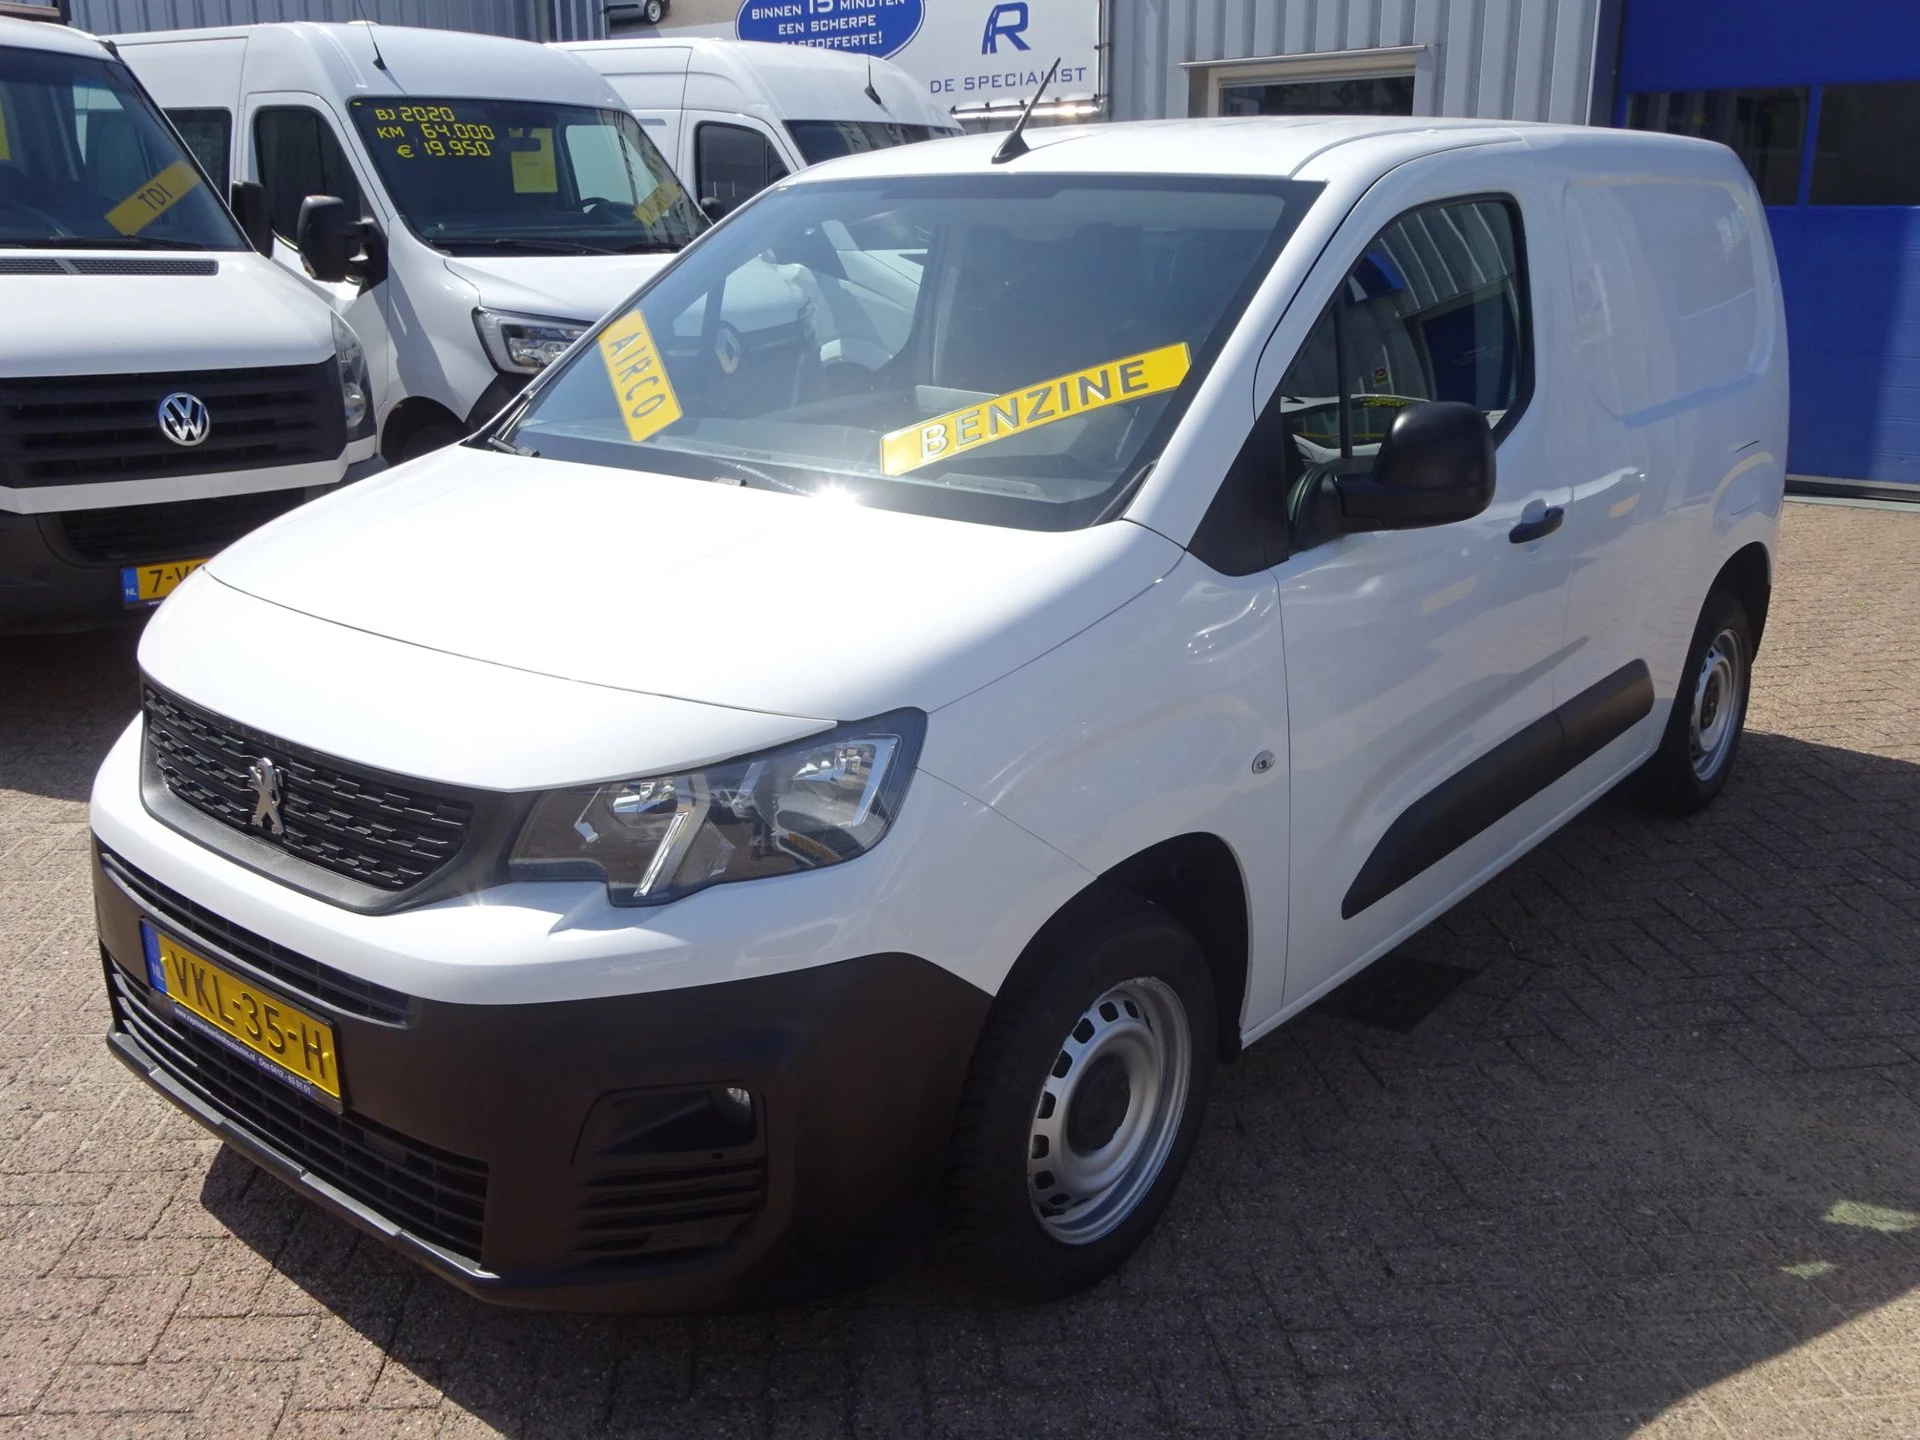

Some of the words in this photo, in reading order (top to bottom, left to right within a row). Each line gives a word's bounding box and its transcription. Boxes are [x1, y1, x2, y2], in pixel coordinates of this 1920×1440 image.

[752, 4, 801, 20] BINNEN
[808, 0, 834, 14] 15
[778, 22, 804, 35] EEN
[811, 15, 876, 32] SCHERPE
[930, 78, 955, 94] DE
[964, 67, 1087, 91] SPECIALIST
[375, 109, 396, 121] BJ
[400, 106, 455, 122] 2020
[377, 126, 405, 139] KM
[421, 123, 495, 140] 64.000
[396, 144, 414, 158] €
[423, 140, 491, 157] 19.950
[138, 182, 174, 211] TDI
[608, 331, 666, 419] AIRCO
[920, 359, 1149, 461] BENZINE
[149, 563, 203, 594] 7-V
[125, 587, 137, 597] NL
[151, 962, 165, 981] NL
[170, 948, 326, 1080] VKL-35-H
